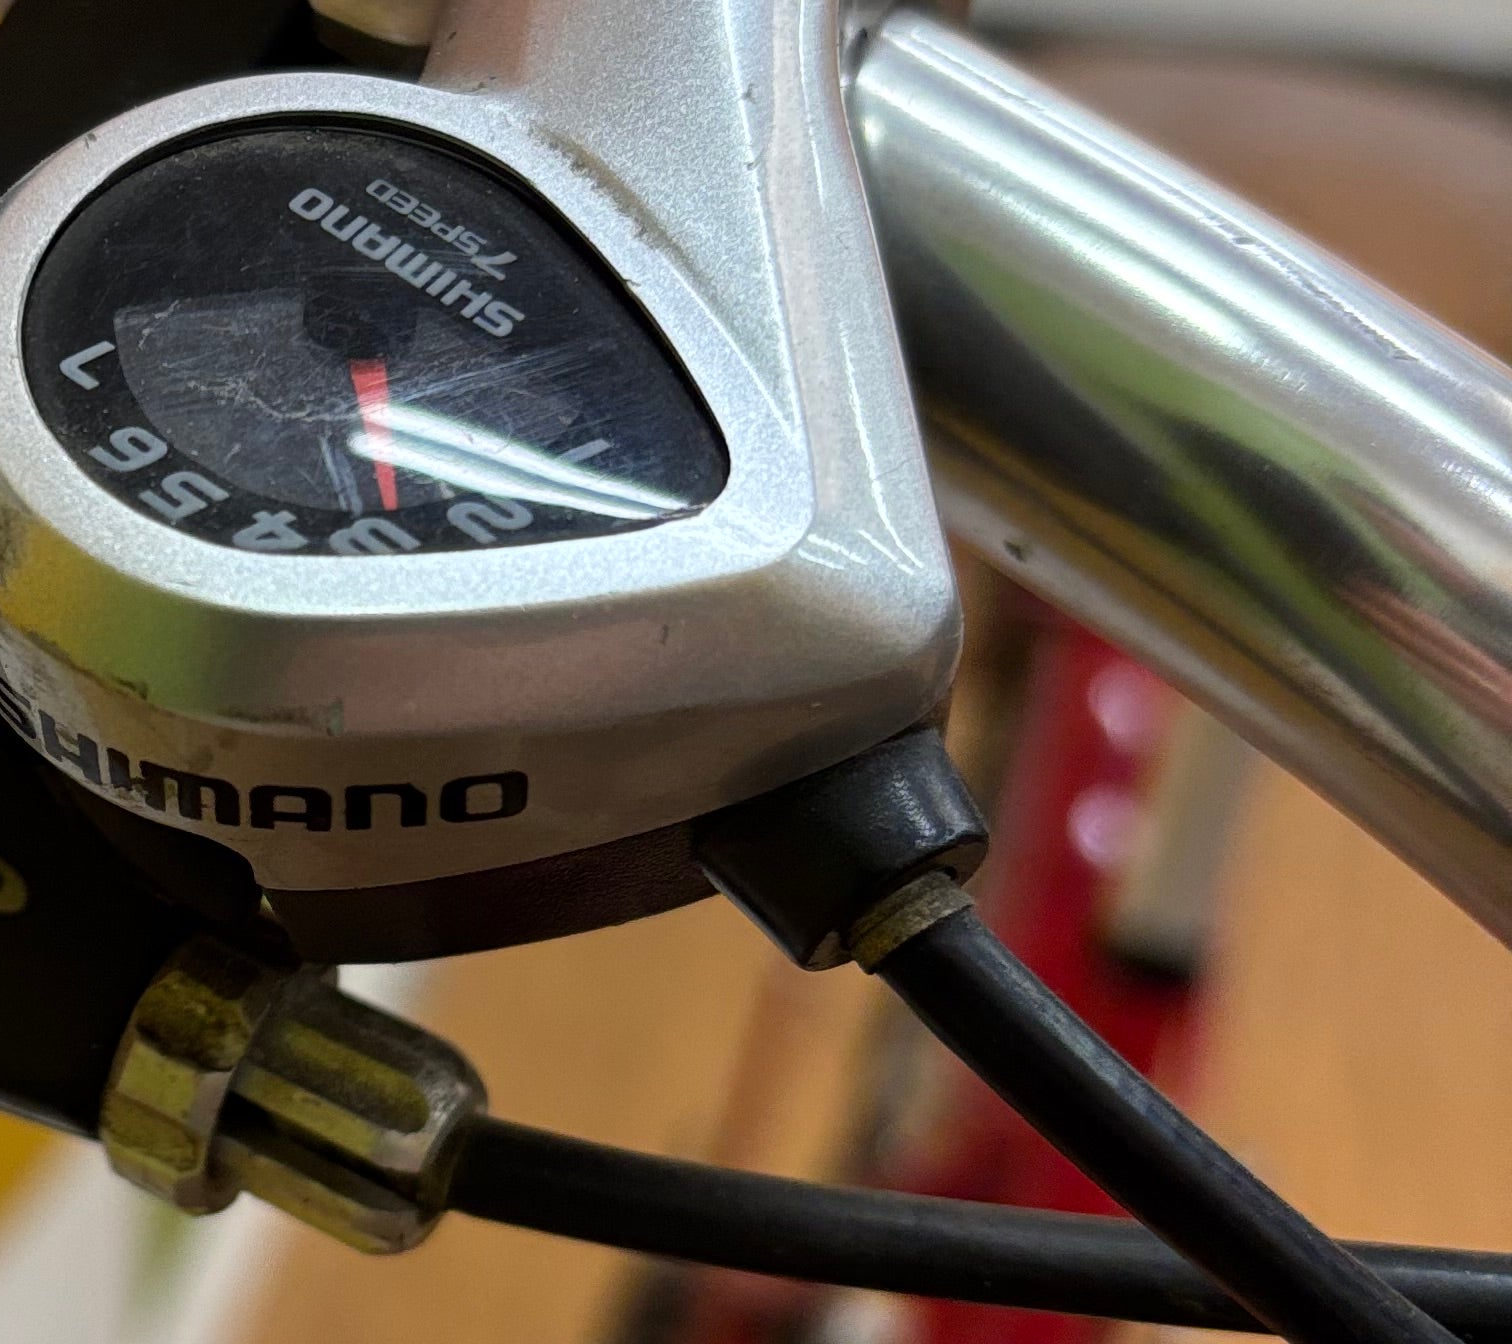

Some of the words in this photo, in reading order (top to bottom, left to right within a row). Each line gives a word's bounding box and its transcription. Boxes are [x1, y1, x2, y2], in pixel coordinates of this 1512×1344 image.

[288, 188, 526, 337] SHIMANO
[59, 340, 116, 390] 7
[89, 426, 168, 472] 6
[140, 471, 230, 530] 5
[446, 497, 534, 544] 2
[232, 510, 309, 551] 4
[329, 517, 421, 555] 3
